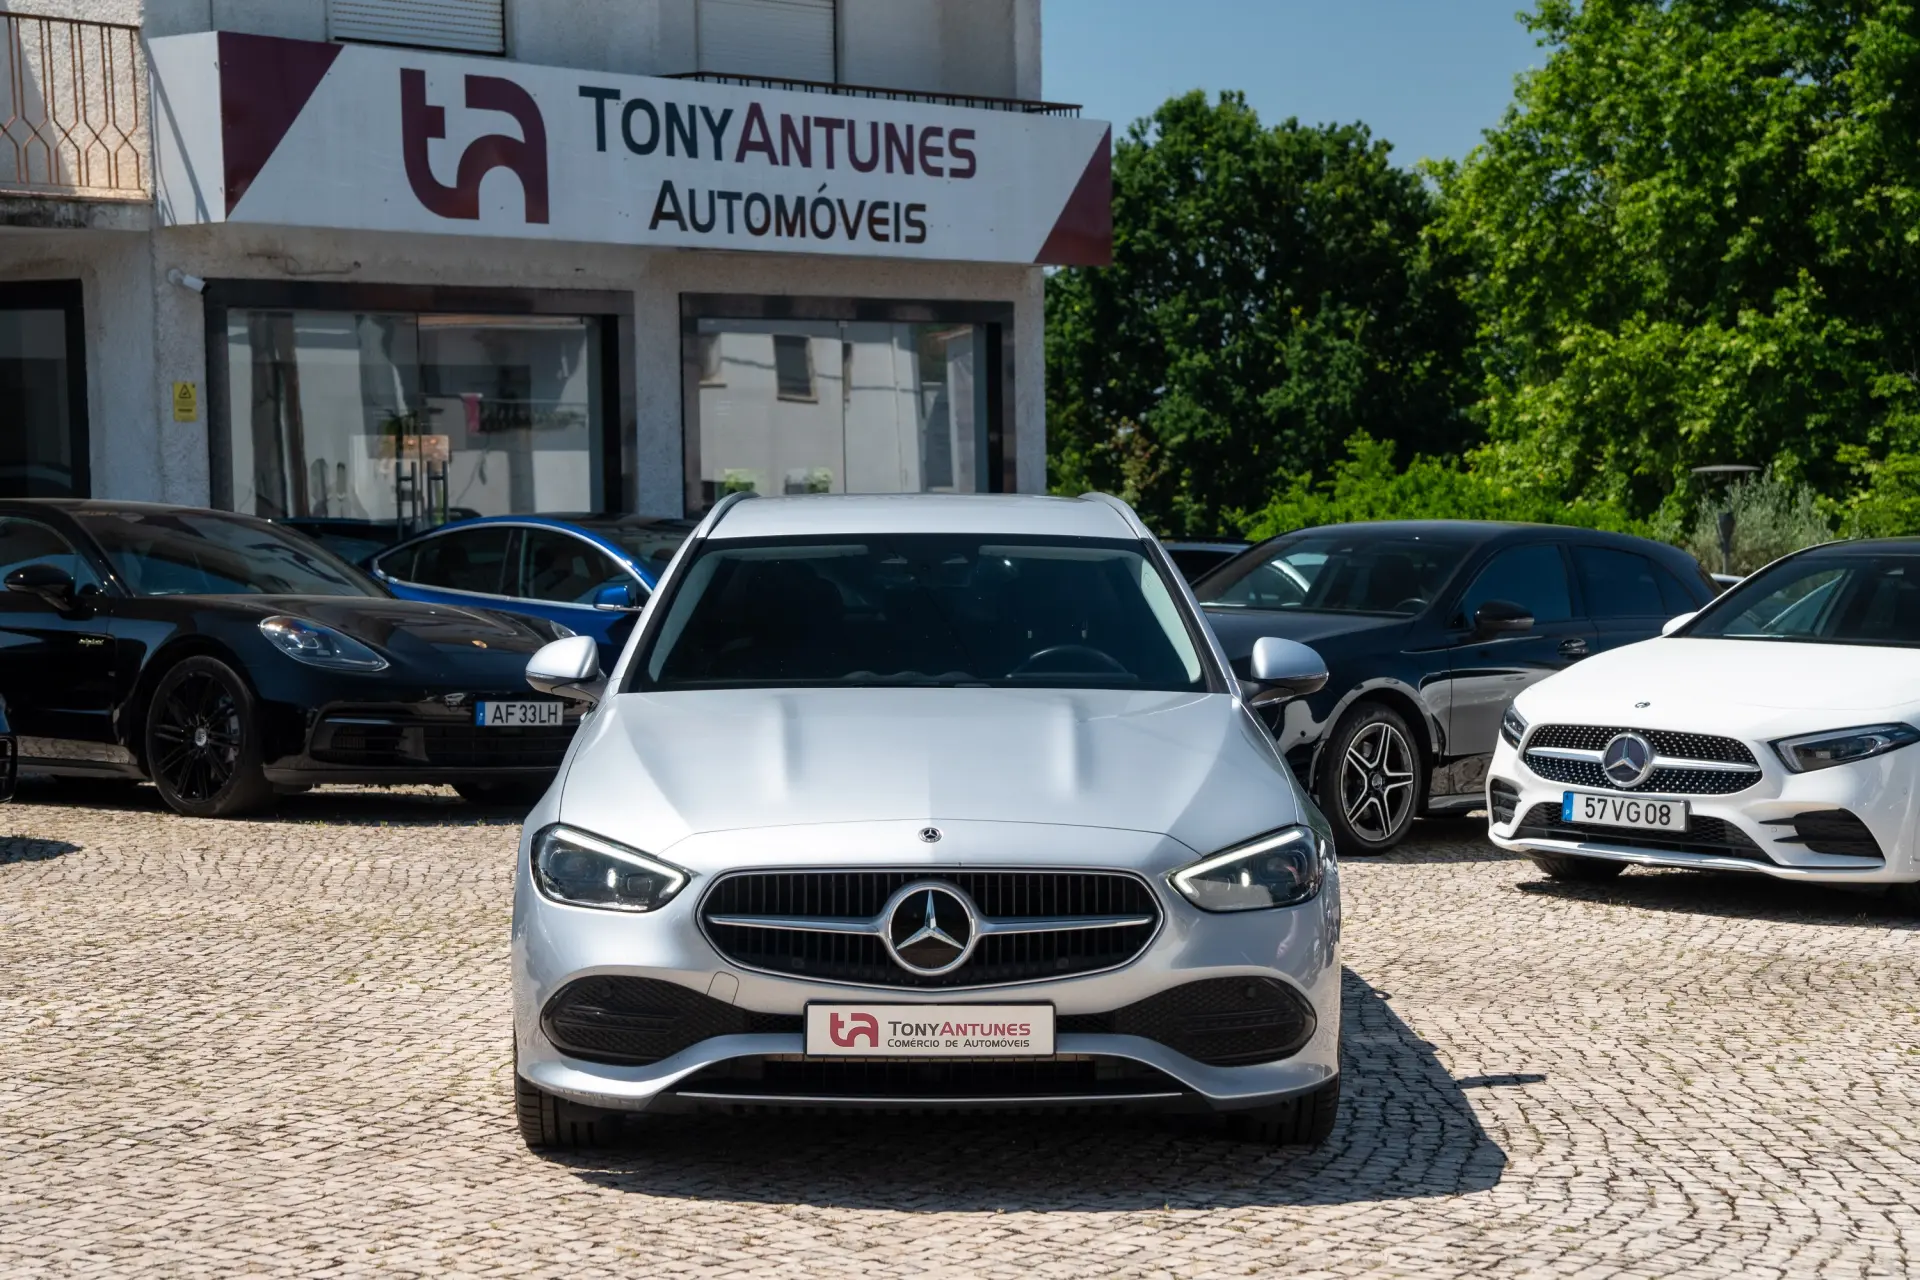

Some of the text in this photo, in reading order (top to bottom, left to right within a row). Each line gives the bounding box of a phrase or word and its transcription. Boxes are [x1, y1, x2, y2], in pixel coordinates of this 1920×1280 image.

[648, 179, 928, 245] AUTOMÓVEIS
[887, 1037, 1030, 1048] COMÉRCIO DE AUTOMÓVEIS
